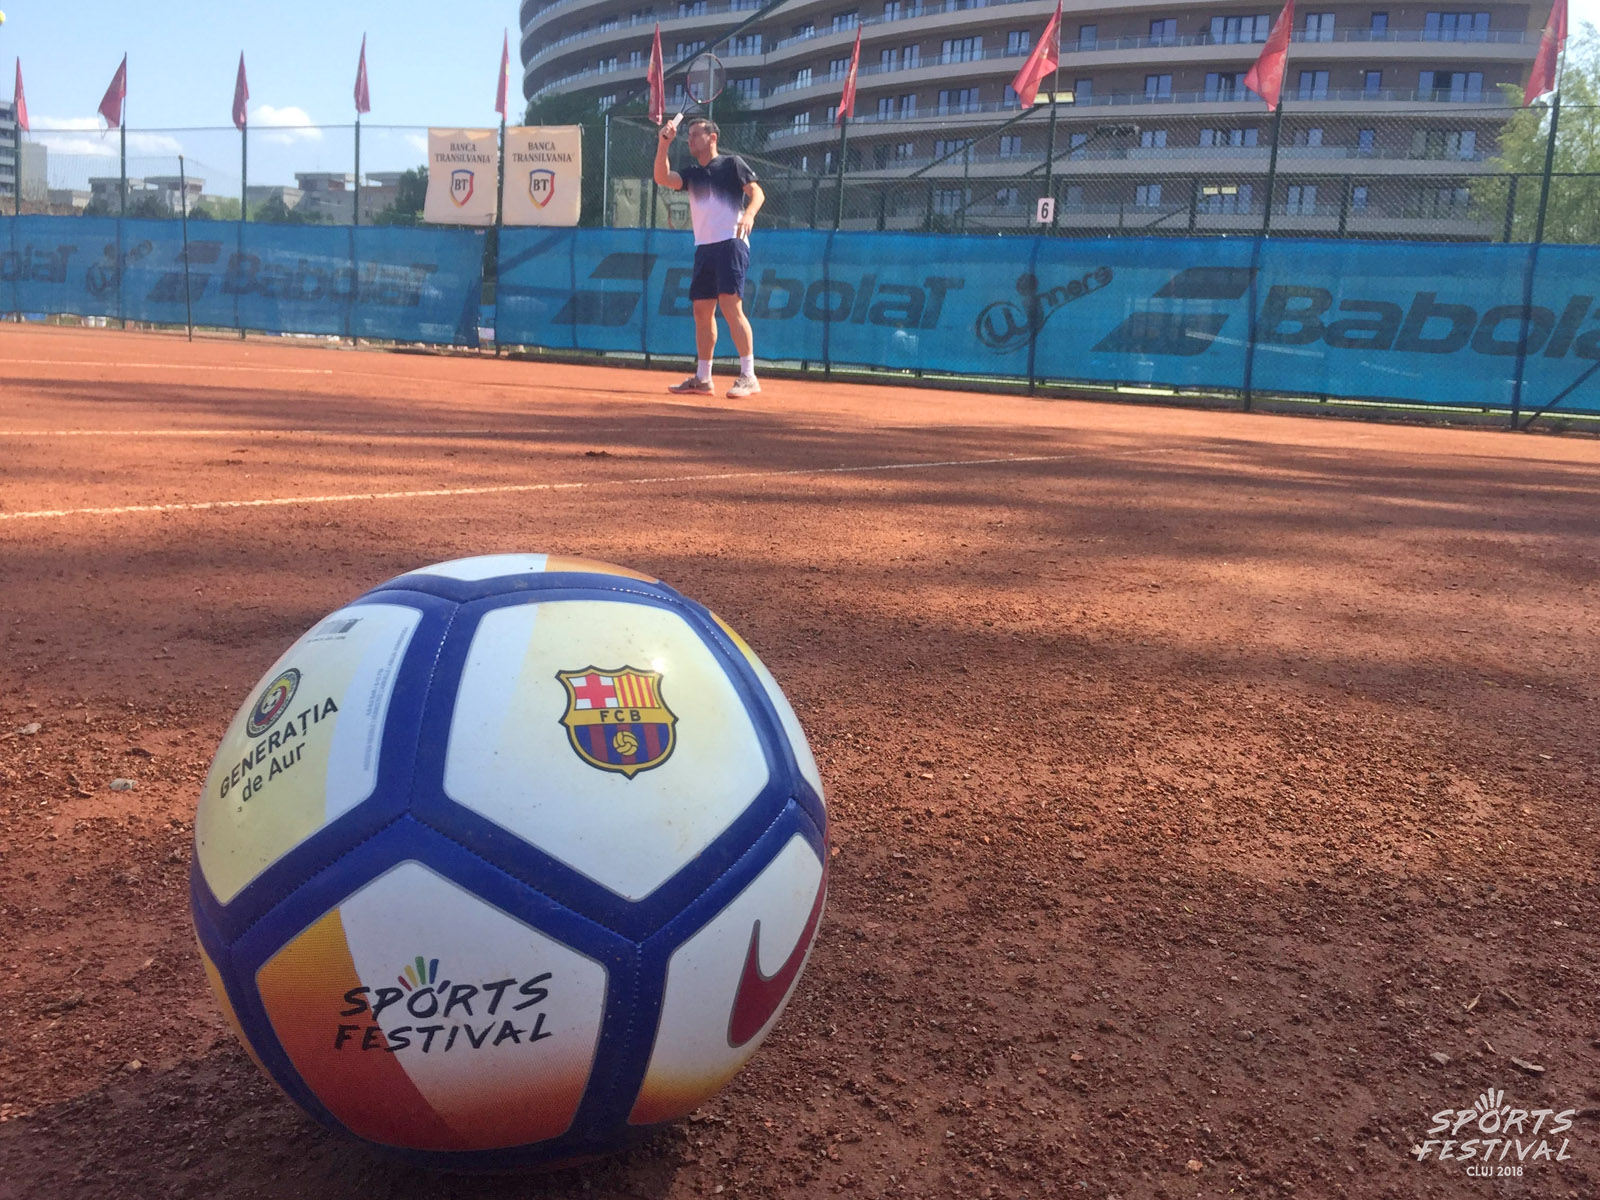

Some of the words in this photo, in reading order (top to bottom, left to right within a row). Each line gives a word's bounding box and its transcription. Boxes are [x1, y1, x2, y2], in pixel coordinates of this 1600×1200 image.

[450, 142, 477, 151] BANCA
[528, 142, 556, 151] BANCA
[435, 153, 491, 163] TRANSILVANIA
[512, 153, 573, 162] TRANSILVANIA
[454, 178, 468, 191] BT
[533, 179, 549, 191] BT
[1041, 202, 1049, 219] 6
[219, 696, 339, 799] GENERAȚIA
[241, 775, 263, 802] de
[268, 742, 305, 782] Aur
[339, 971, 552, 1021] SPORTS
[334, 1013, 552, 1053] FESTIVAL
